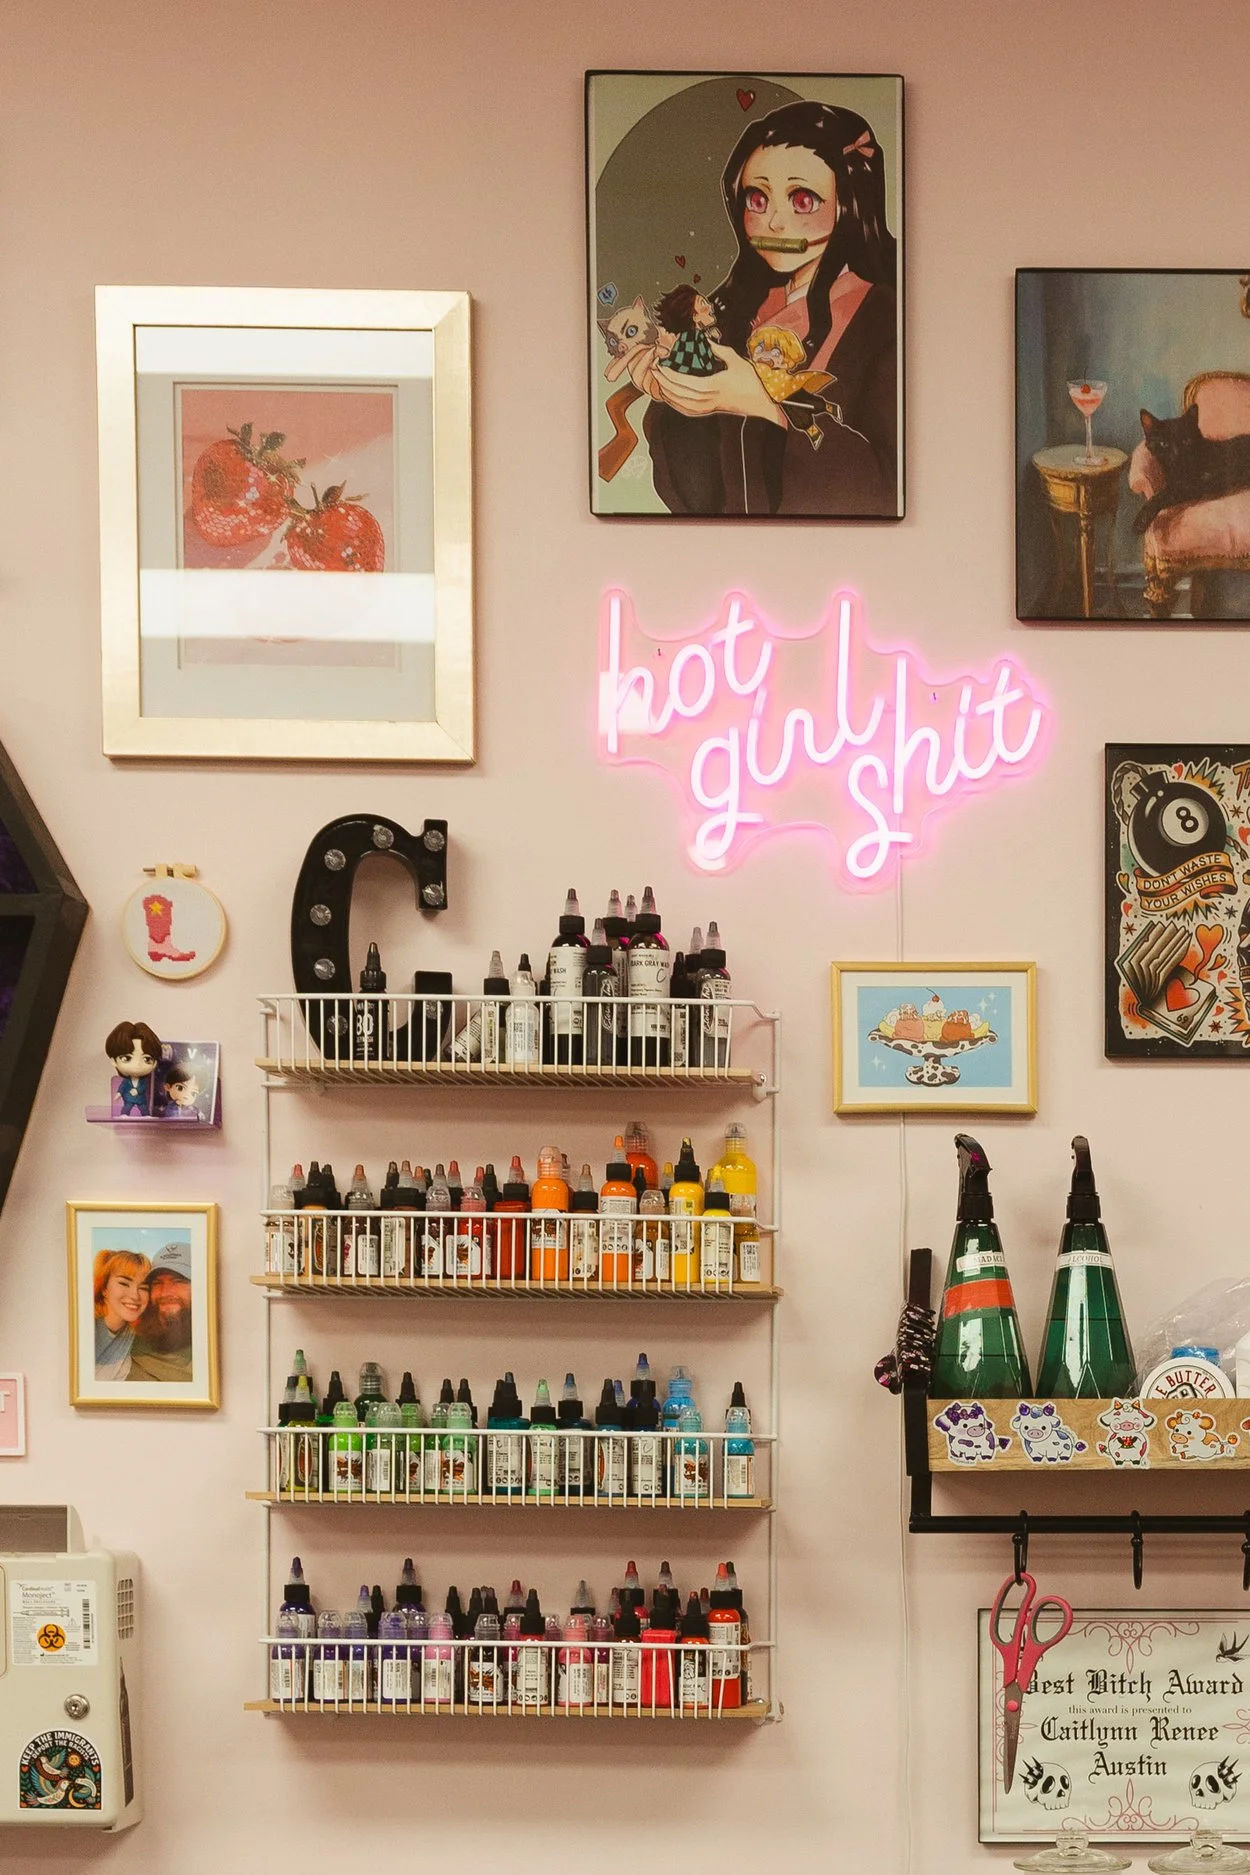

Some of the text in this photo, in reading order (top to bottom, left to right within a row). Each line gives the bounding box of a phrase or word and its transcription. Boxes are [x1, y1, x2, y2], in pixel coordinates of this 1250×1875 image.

[607, 597, 773, 753] hot
[690, 598, 886, 860] girl
[845, 655, 1043, 878] shit
[1175, 806, 1200, 833] 8
[1142, 853, 1222, 890] DON'T WASTE
[1144, 871, 1228, 911] YOUR WISHES
[1165, 1369, 1216, 1394] BUTTER
[1085, 1668, 1152, 1703] Bitch
[1162, 1668, 1244, 1703] Award
[1068, 1706, 1192, 1717] this award is presented to
[21, 1731, 99, 1766] KEEP THE IMMIGRANTS
[1040, 1715, 1220, 1749] Caitlynn Renee
[1088, 1751, 1168, 1785] Austin
